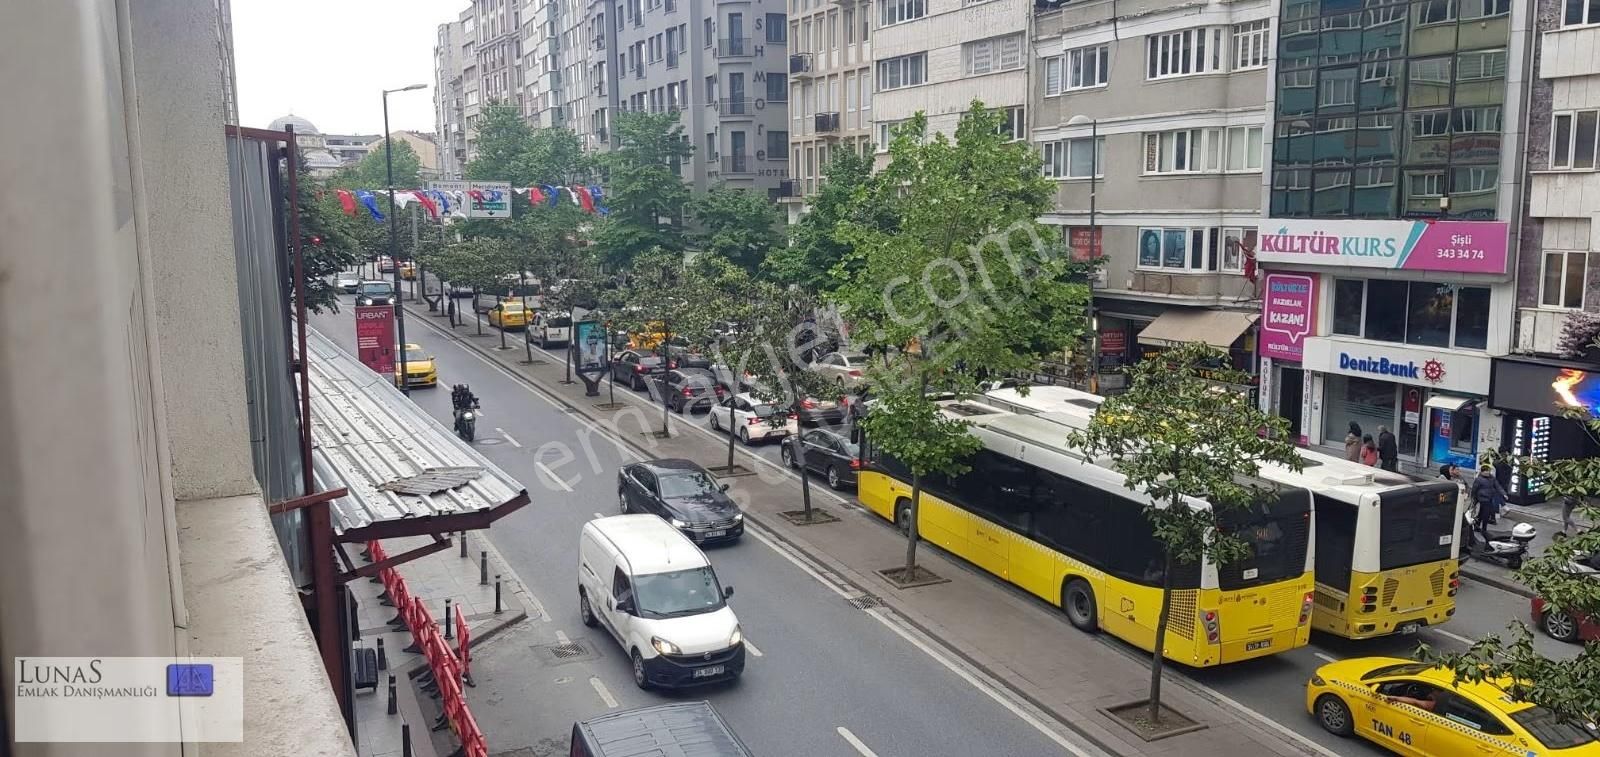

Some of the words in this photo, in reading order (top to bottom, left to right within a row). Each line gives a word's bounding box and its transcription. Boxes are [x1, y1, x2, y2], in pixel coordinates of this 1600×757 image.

[1451, 234, 1472, 247] Şişli
[1437, 248, 1455, 259] 343
[1457, 249, 1470, 259] 34
[1472, 250, 1484, 260] 74
[1270, 311, 1304, 327] KAZAN!
[1340, 352, 1419, 379] DenizBank
[1372, 718, 1393, 738] TAN
